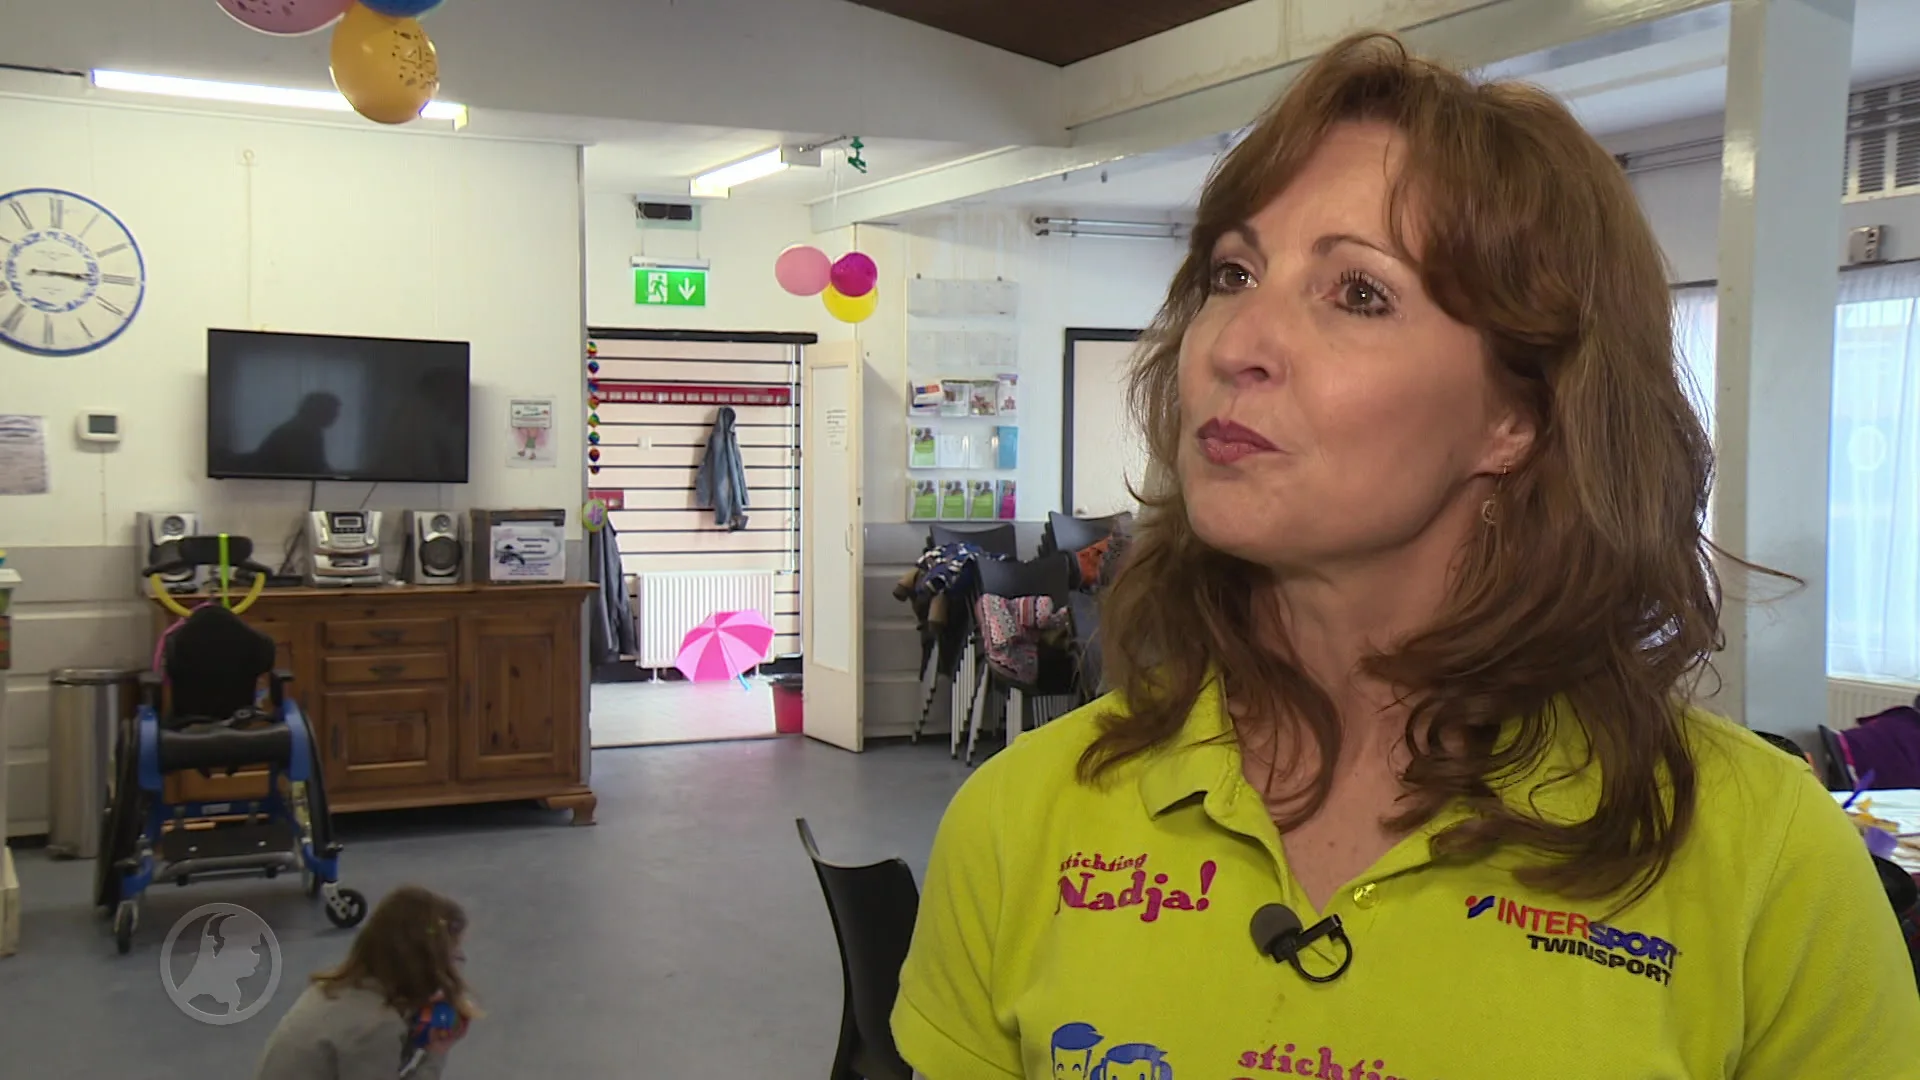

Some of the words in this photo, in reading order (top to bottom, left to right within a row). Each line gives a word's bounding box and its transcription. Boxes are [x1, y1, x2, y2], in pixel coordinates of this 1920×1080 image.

[1054, 859, 1218, 923] Nadja!
[1058, 851, 1149, 872] stichting
[1497, 896, 1678, 970] INTERSPORT
[1526, 933, 1673, 988] TWINSPORT
